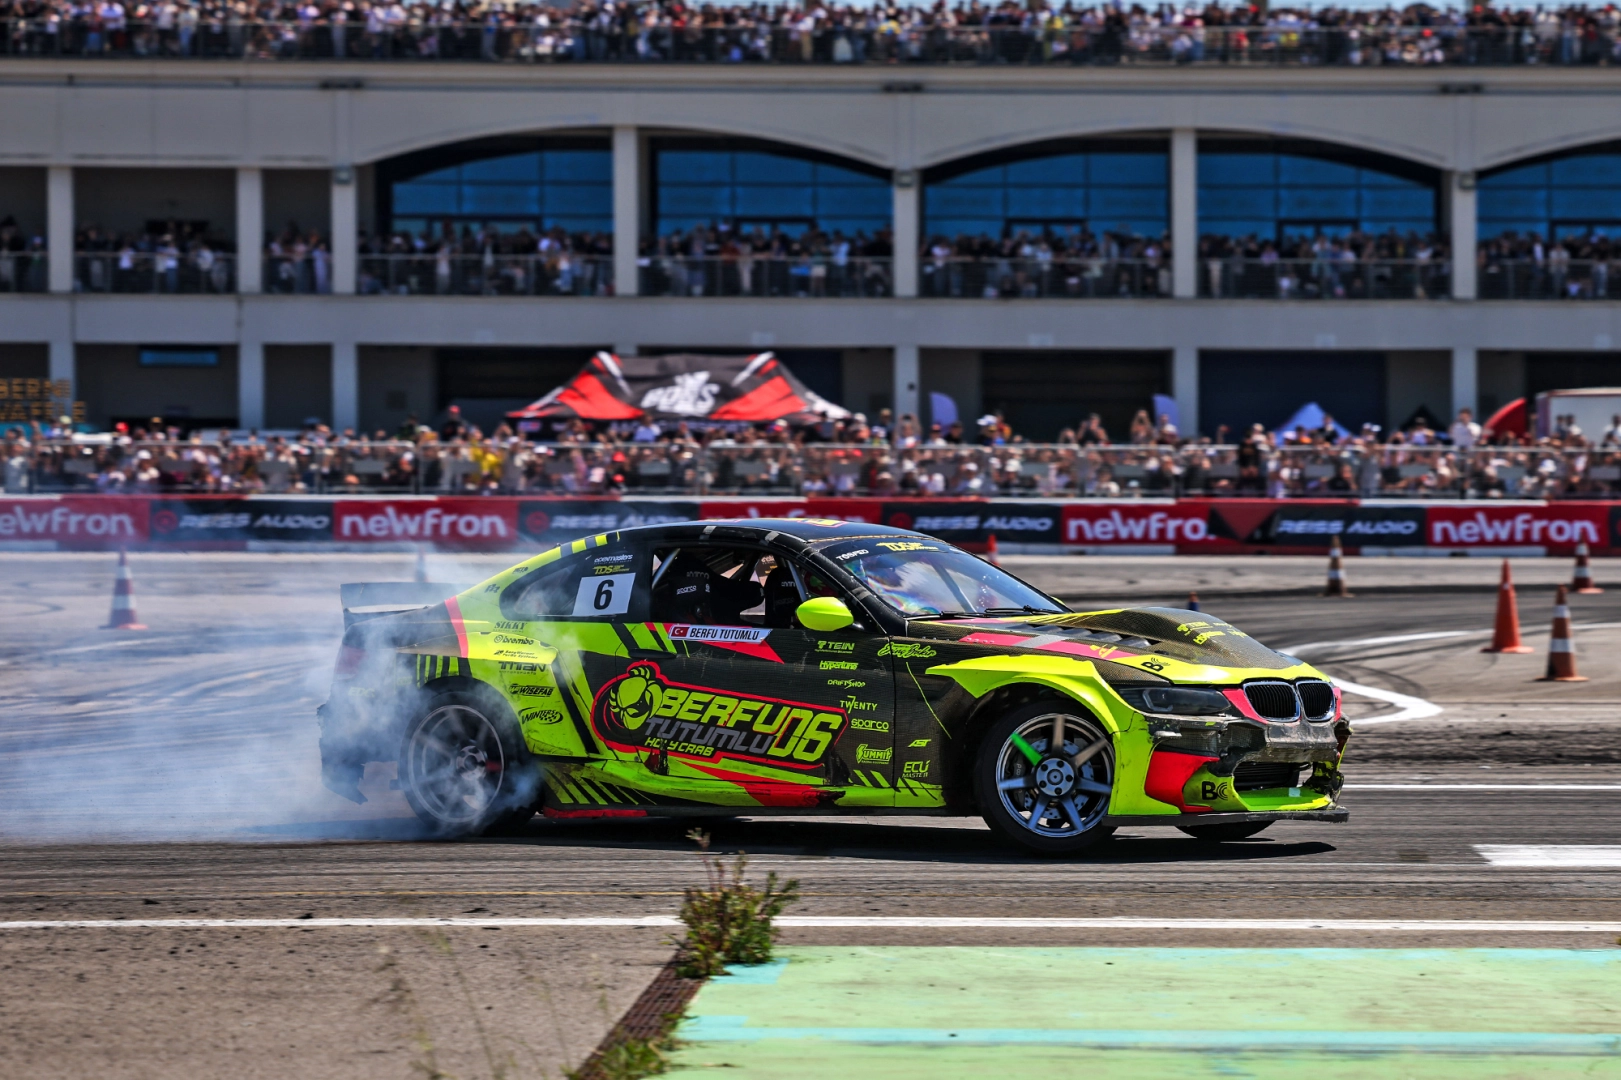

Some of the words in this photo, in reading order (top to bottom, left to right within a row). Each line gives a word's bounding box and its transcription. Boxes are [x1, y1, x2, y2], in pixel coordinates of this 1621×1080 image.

[253, 514, 330, 529] AUDIO
[341, 505, 508, 537] newfron
[982, 517, 1053, 531] AUDIO
[1067, 509, 1217, 541] newfro
[1277, 519, 1345, 534] REISS
[1346, 520, 1418, 535] AUDIO
[1432, 511, 1599, 543] newfron
[593, 579, 614, 610] 6
[503, 636, 534, 645] brembo
[689, 627, 718, 638] BERFU
[719, 628, 760, 640] TUTUMLU
[828, 641, 855, 650] TEIN
[520, 686, 554, 696] WISEFAB
[521, 709, 558, 725] WINTERS
[657, 688, 791, 733] BERFU
[851, 718, 889, 730] sparco
[645, 717, 779, 755] TUTUMLU
[677, 742, 715, 757] CRAB
[856, 744, 893, 764] SUMMIT
